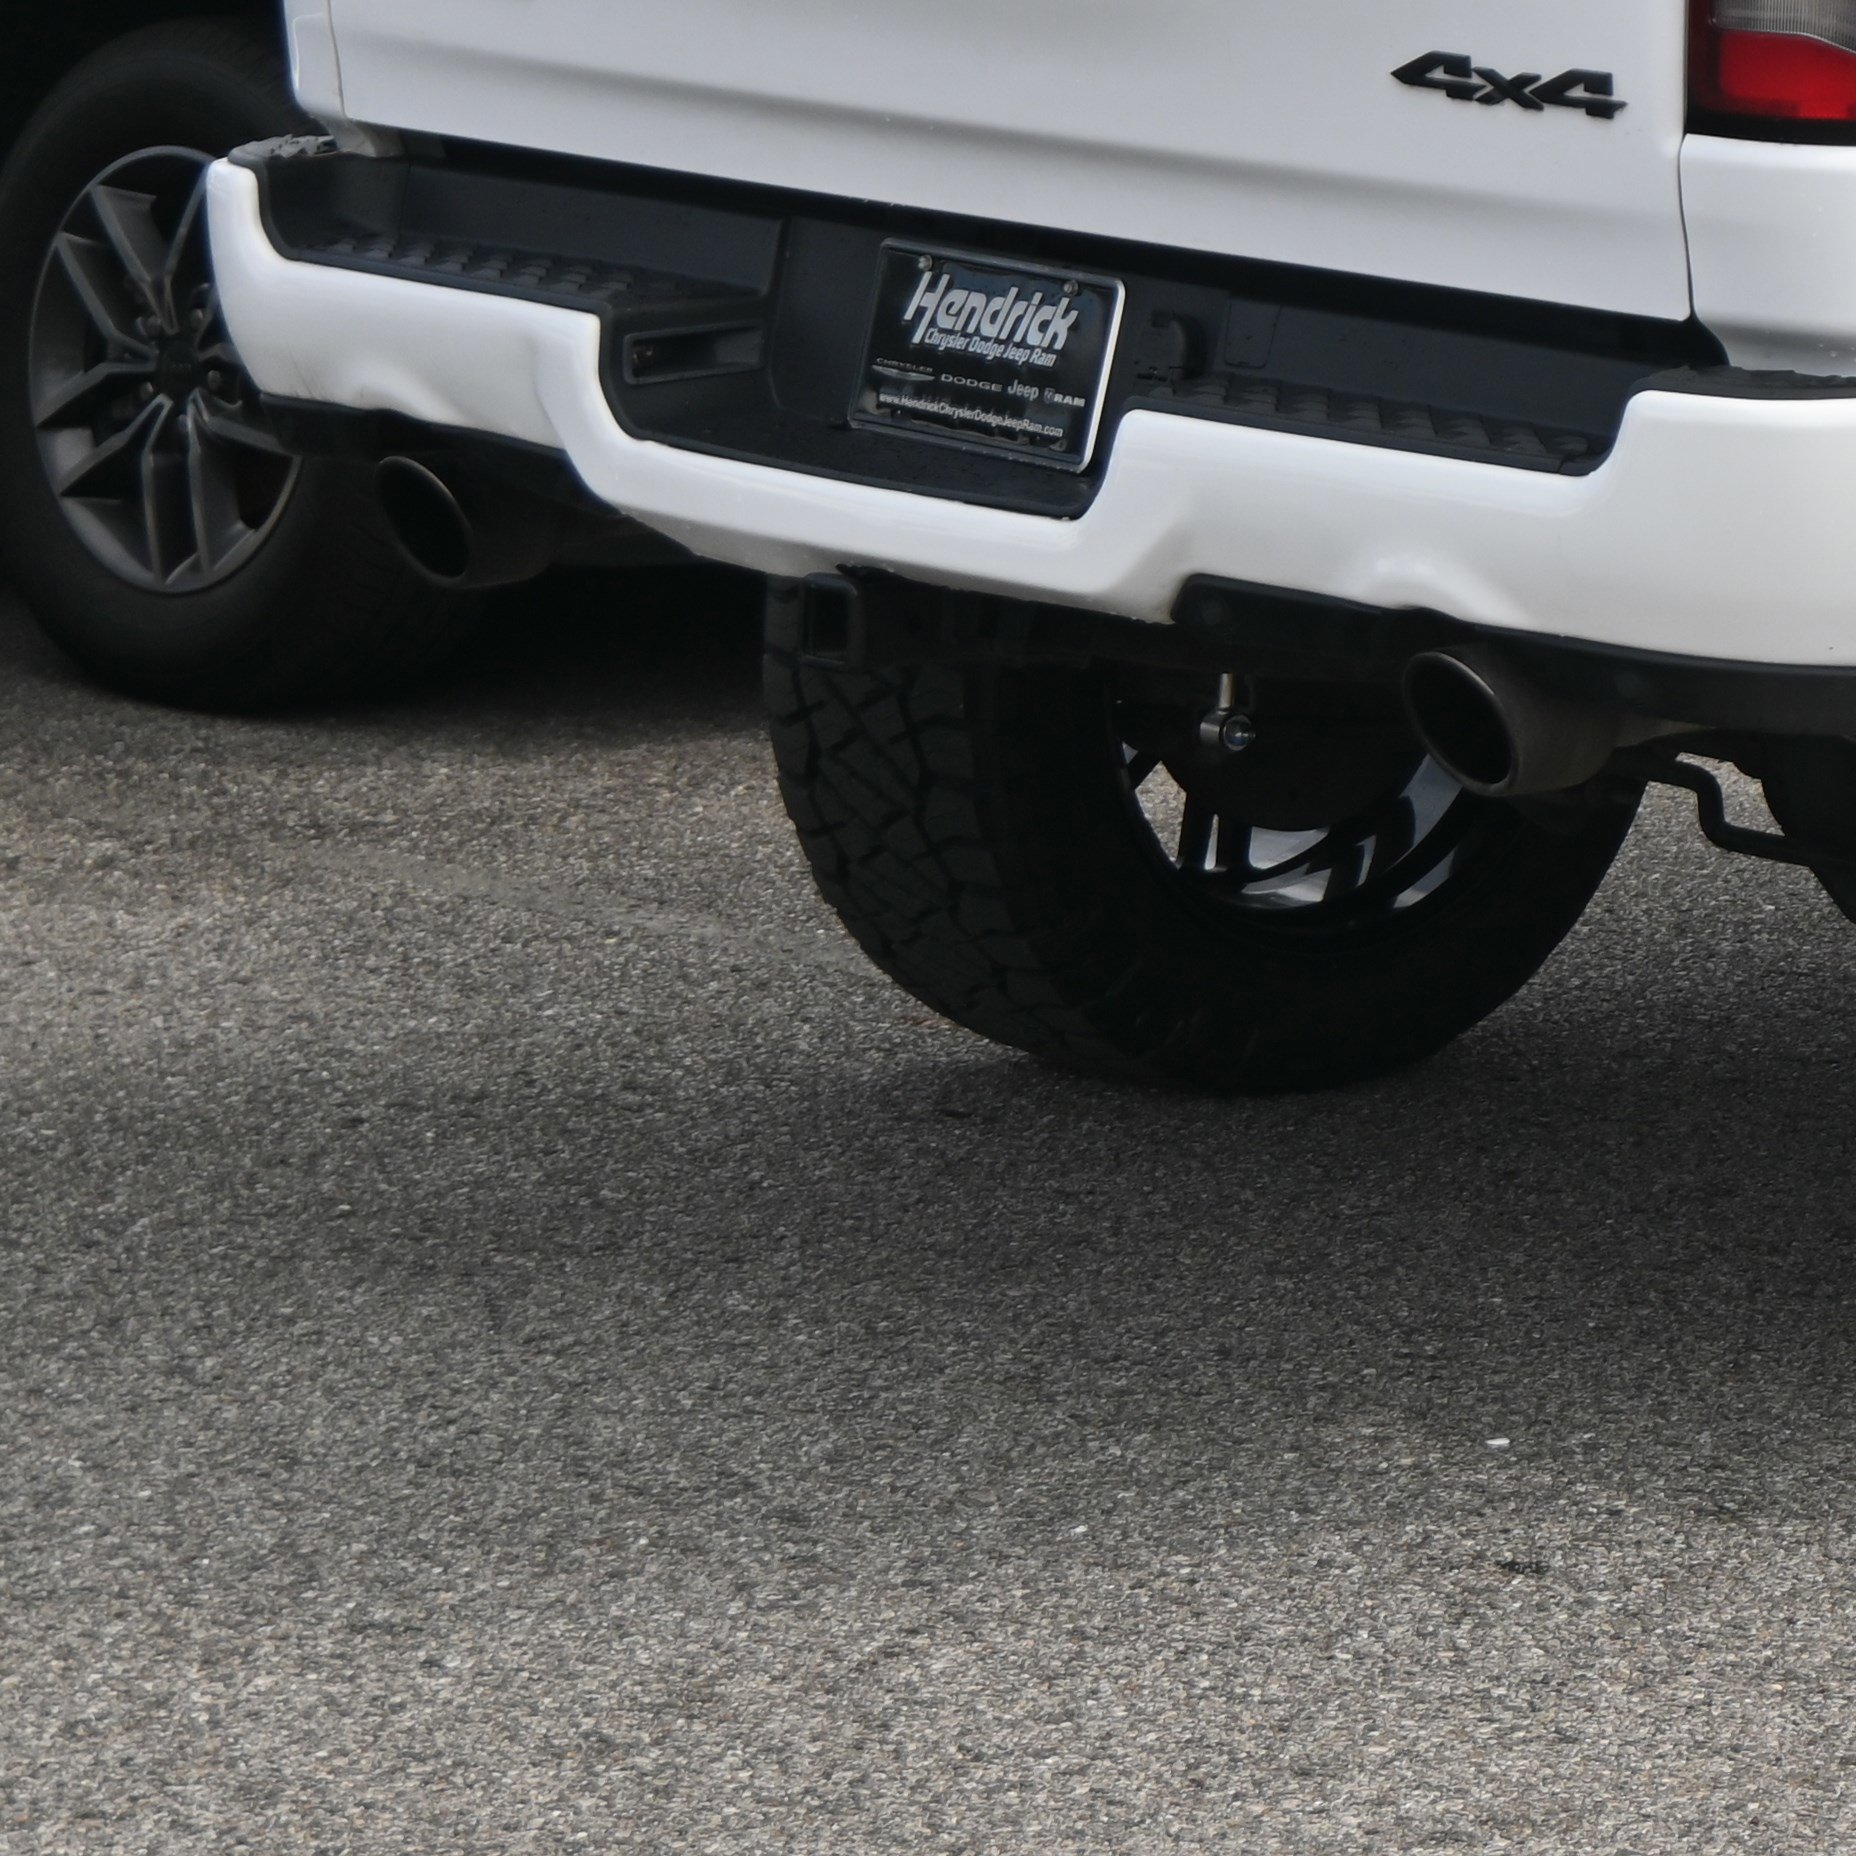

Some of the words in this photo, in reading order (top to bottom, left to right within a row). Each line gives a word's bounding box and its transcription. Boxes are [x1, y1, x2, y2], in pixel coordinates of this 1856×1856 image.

[904, 270, 1079, 351] Hendrick
[924, 327, 970, 352] Chrysler
[968, 335, 1003, 359] Dodge
[1002, 343, 1031, 365] Jeep
[1032, 348, 1057, 368] Ram
[876, 357, 934, 373] CHRYSLER
[940, 373, 1004, 393] DODGE
[1007, 379, 1040, 400] Jeep
[1053, 393, 1087, 408] RAM
